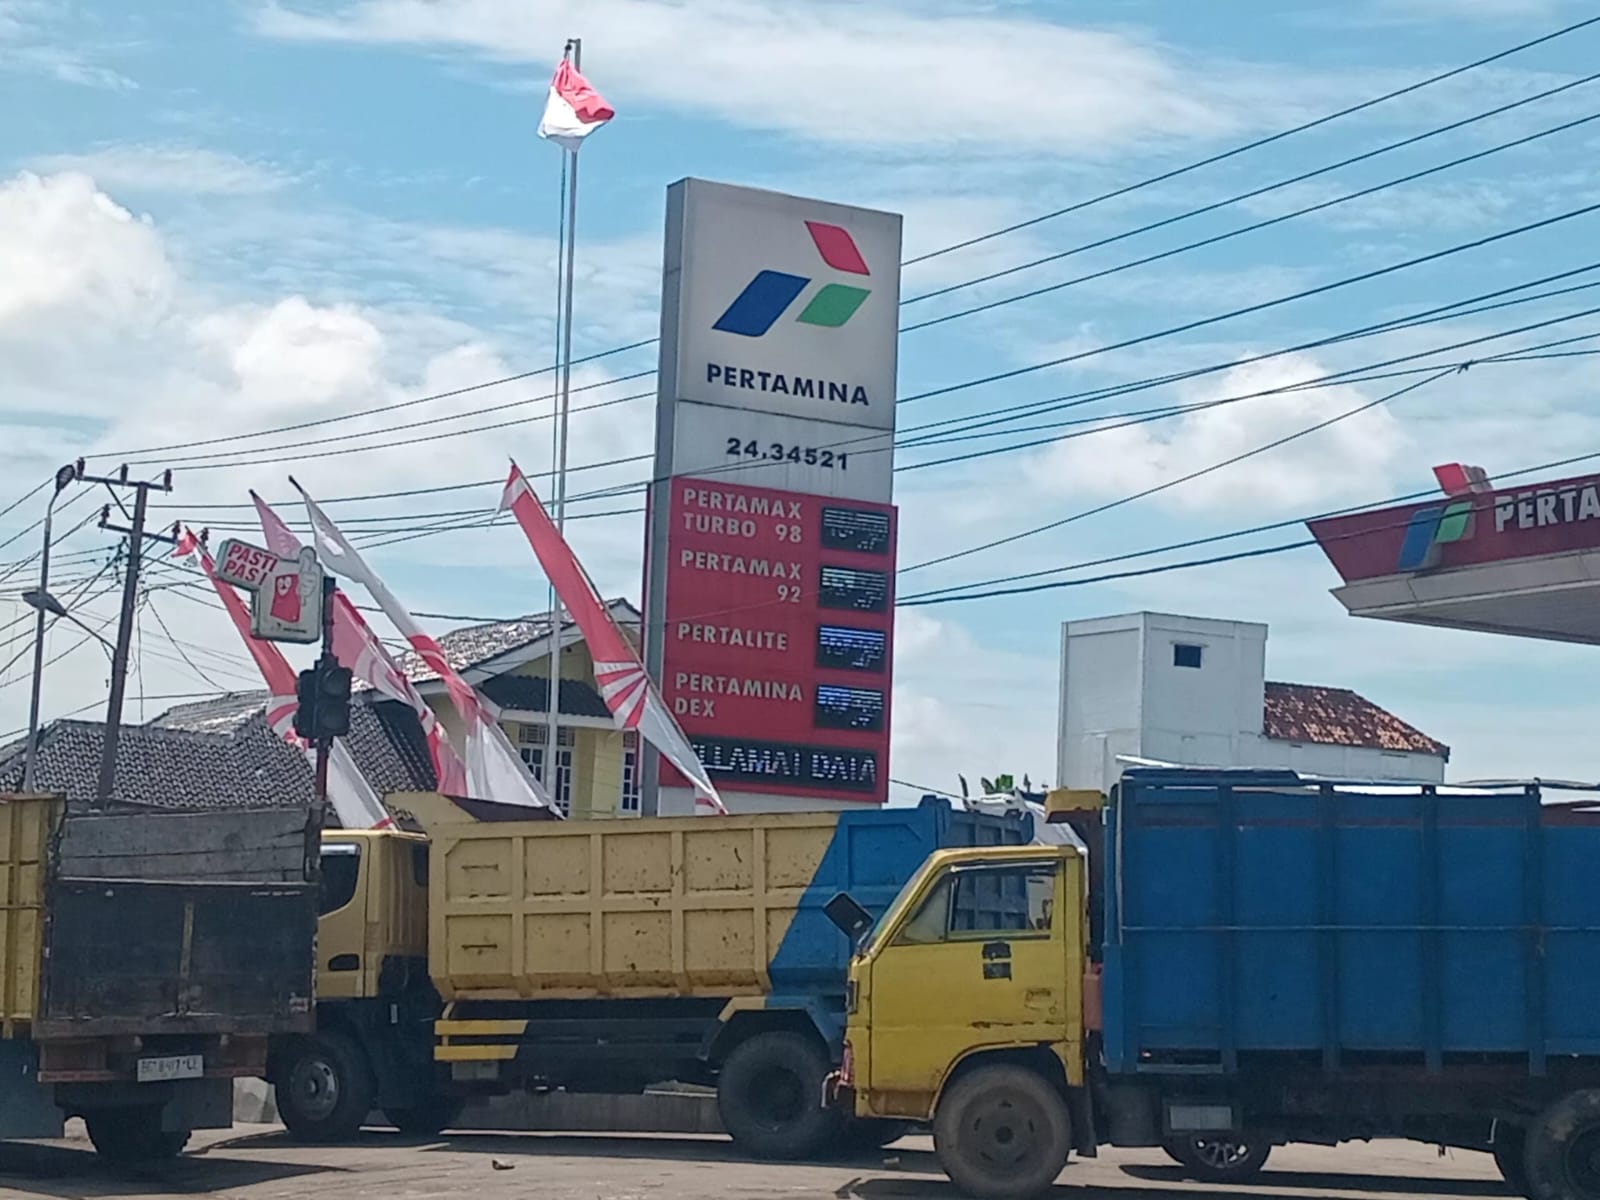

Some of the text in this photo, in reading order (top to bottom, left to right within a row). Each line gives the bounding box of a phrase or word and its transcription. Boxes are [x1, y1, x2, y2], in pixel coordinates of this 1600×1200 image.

[706, 362, 870, 406] PERTAMINA
[683, 487, 802, 519] PERTAMAX
[1494, 482, 1600, 532] PERTA
[682, 511, 757, 538] TURBO
[775, 523, 802, 543] 98
[227, 542, 278, 572] PASTI
[680, 549, 802, 581] PERTAMAX
[777, 584, 801, 603] 92
[677, 622, 788, 651] PERTALITE
[675, 672, 803, 702] PERTAMINA
[674, 697, 716, 718] DEX
